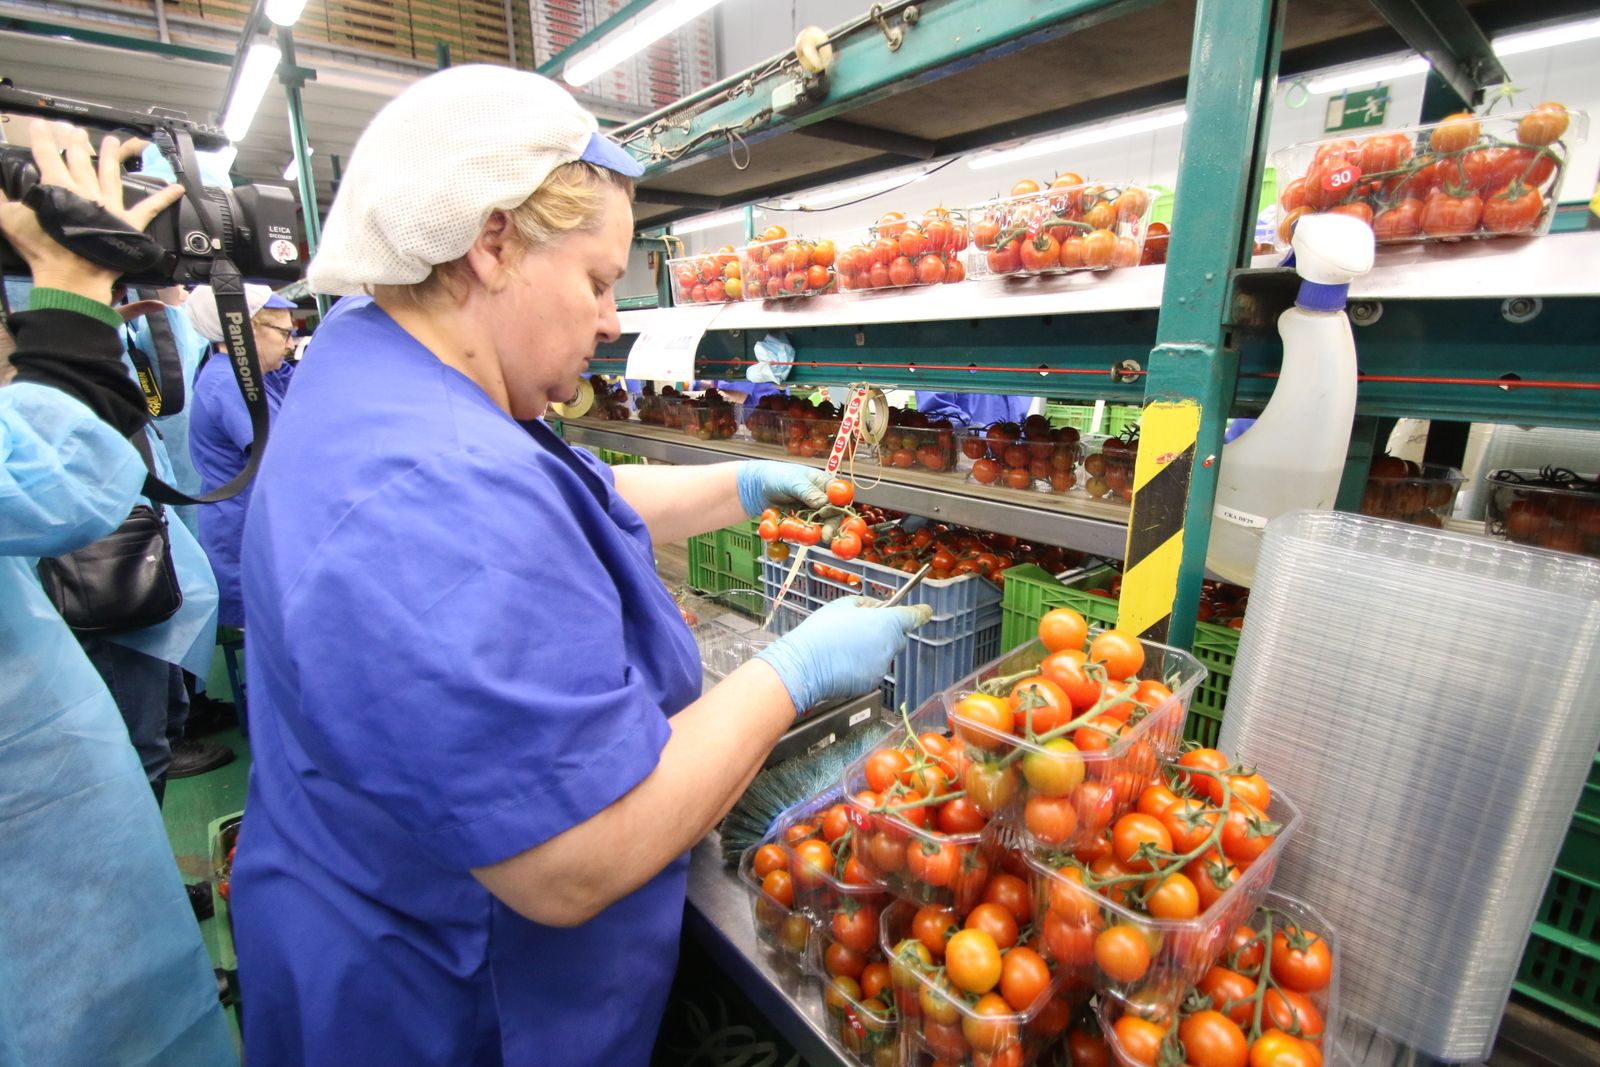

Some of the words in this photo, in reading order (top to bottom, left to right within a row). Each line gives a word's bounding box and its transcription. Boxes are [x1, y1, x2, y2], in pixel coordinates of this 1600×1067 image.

[1331, 170, 1351, 187] 30
[269, 225, 291, 234] LEICA
[226, 312, 259, 401] Panasonic
[138, 371, 151, 393] Nikon
